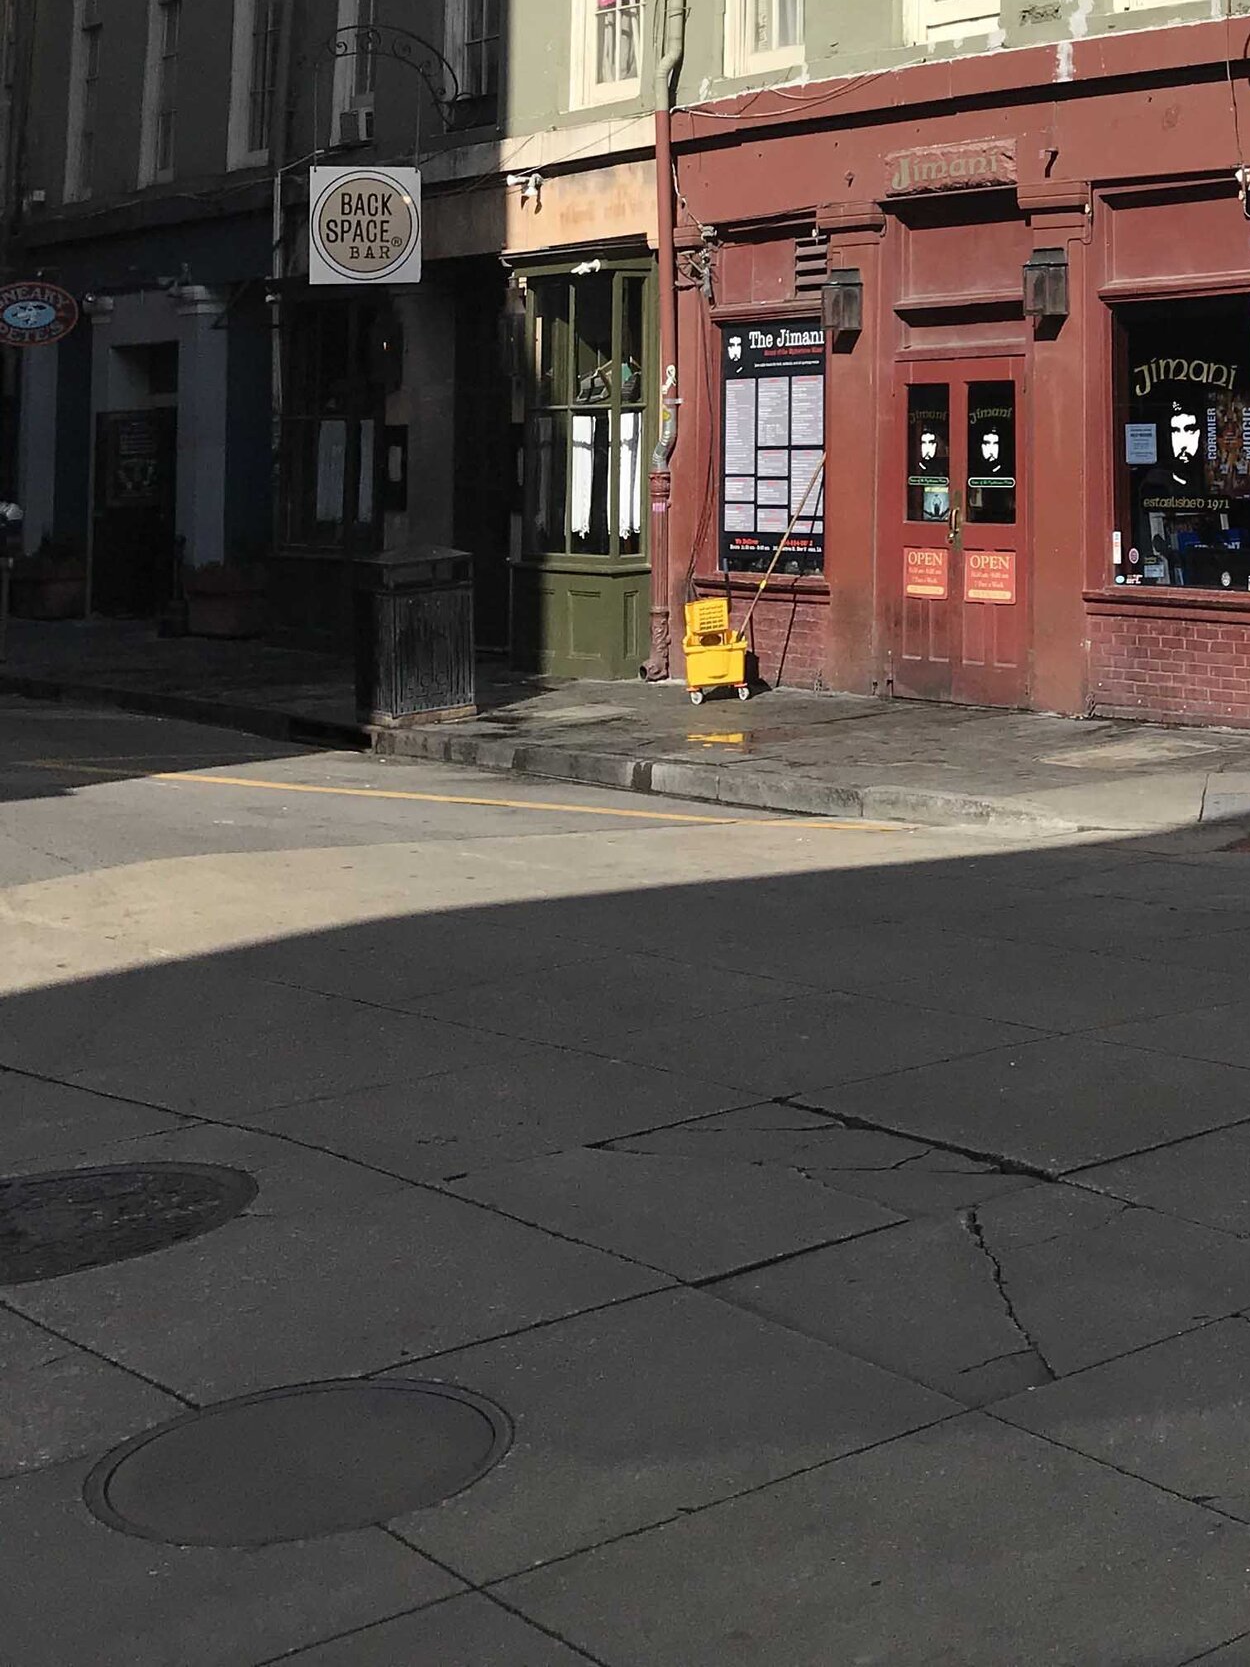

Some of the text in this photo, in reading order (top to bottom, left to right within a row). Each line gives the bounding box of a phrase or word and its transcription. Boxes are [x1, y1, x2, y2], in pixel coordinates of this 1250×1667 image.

[891, 152, 998, 190] Jimani
[340, 192, 393, 217] BACK
[326, 218, 391, 243] SPACE
[348, 245, 391, 260] BAR
[749, 328, 825, 349] The Jimani
[1134, 357, 1238, 397] Jimani
[968, 406, 1013, 425] Jimani
[1206, 407, 1218, 460] CORMIER
[1206, 499, 1230, 511] 1971
[908, 551, 943, 566] OPEN
[969, 554, 1011, 570] OPEN
